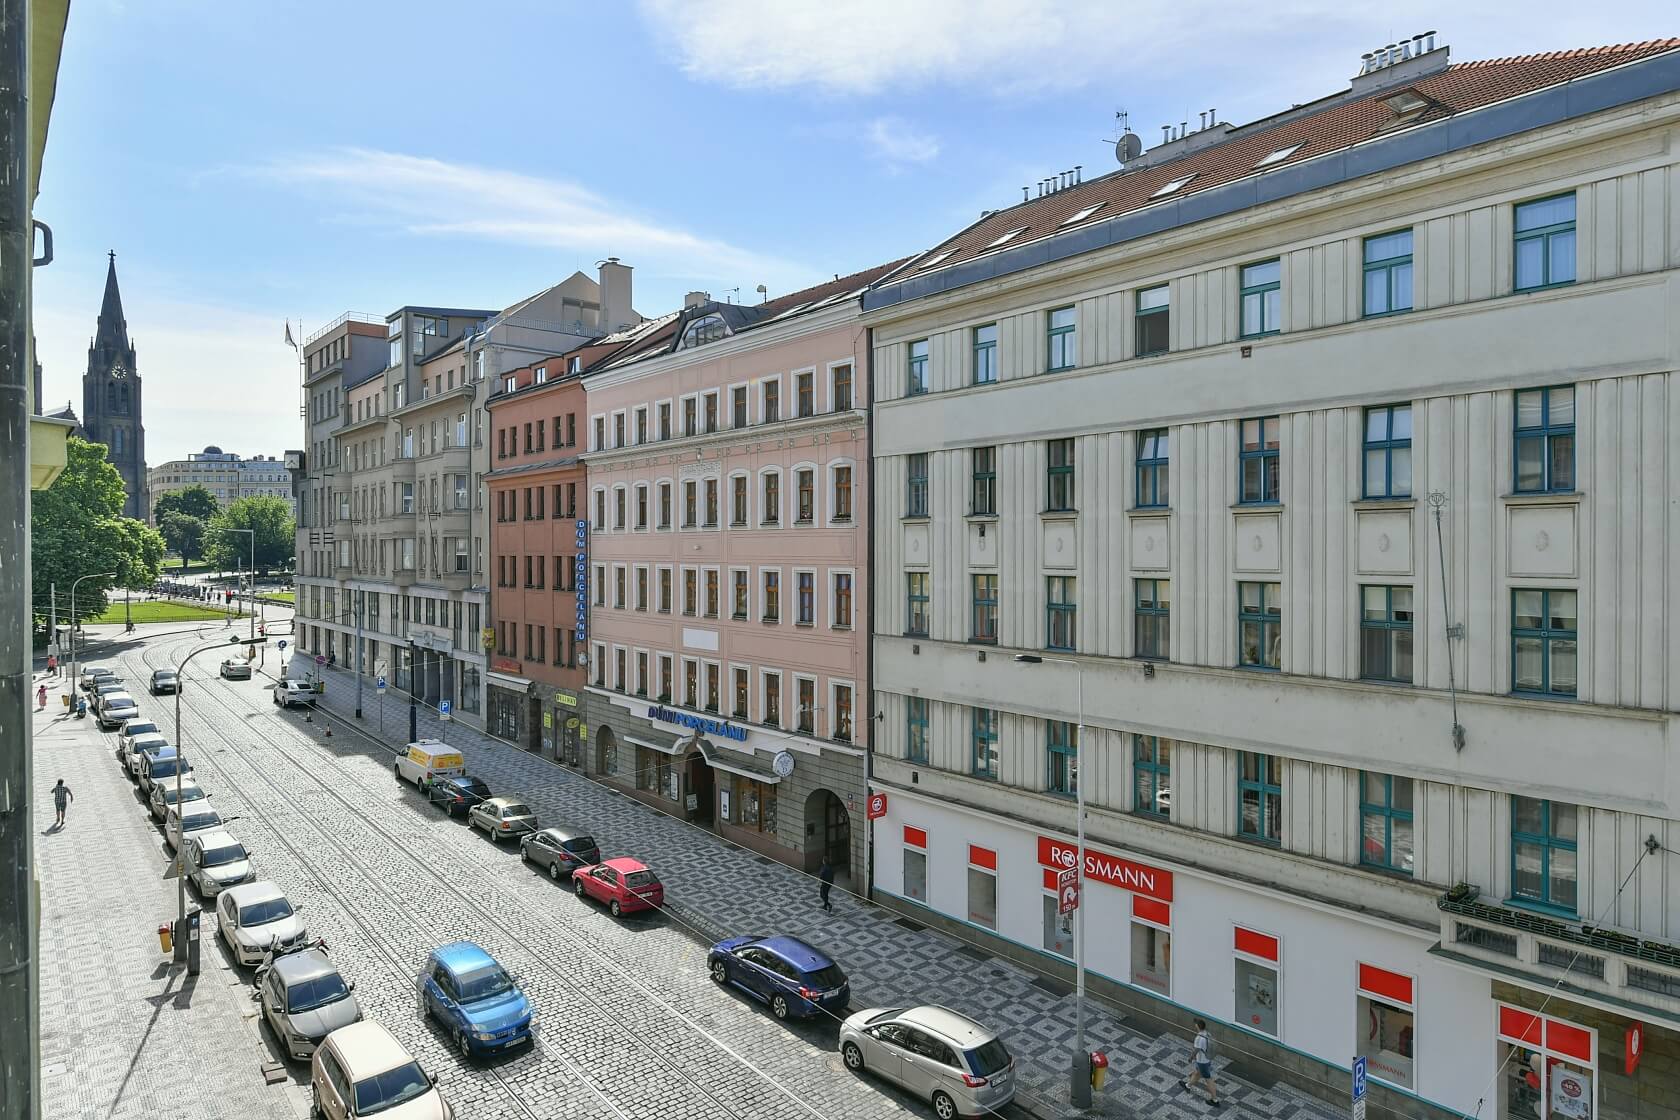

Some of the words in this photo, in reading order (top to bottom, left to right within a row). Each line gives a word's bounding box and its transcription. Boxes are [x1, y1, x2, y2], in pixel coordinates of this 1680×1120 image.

[441, 702, 449, 711] P
[1061, 869, 1078, 882] KFC
[1063, 903, 1072, 912] 150
[1355, 1062, 1364, 1089] P
